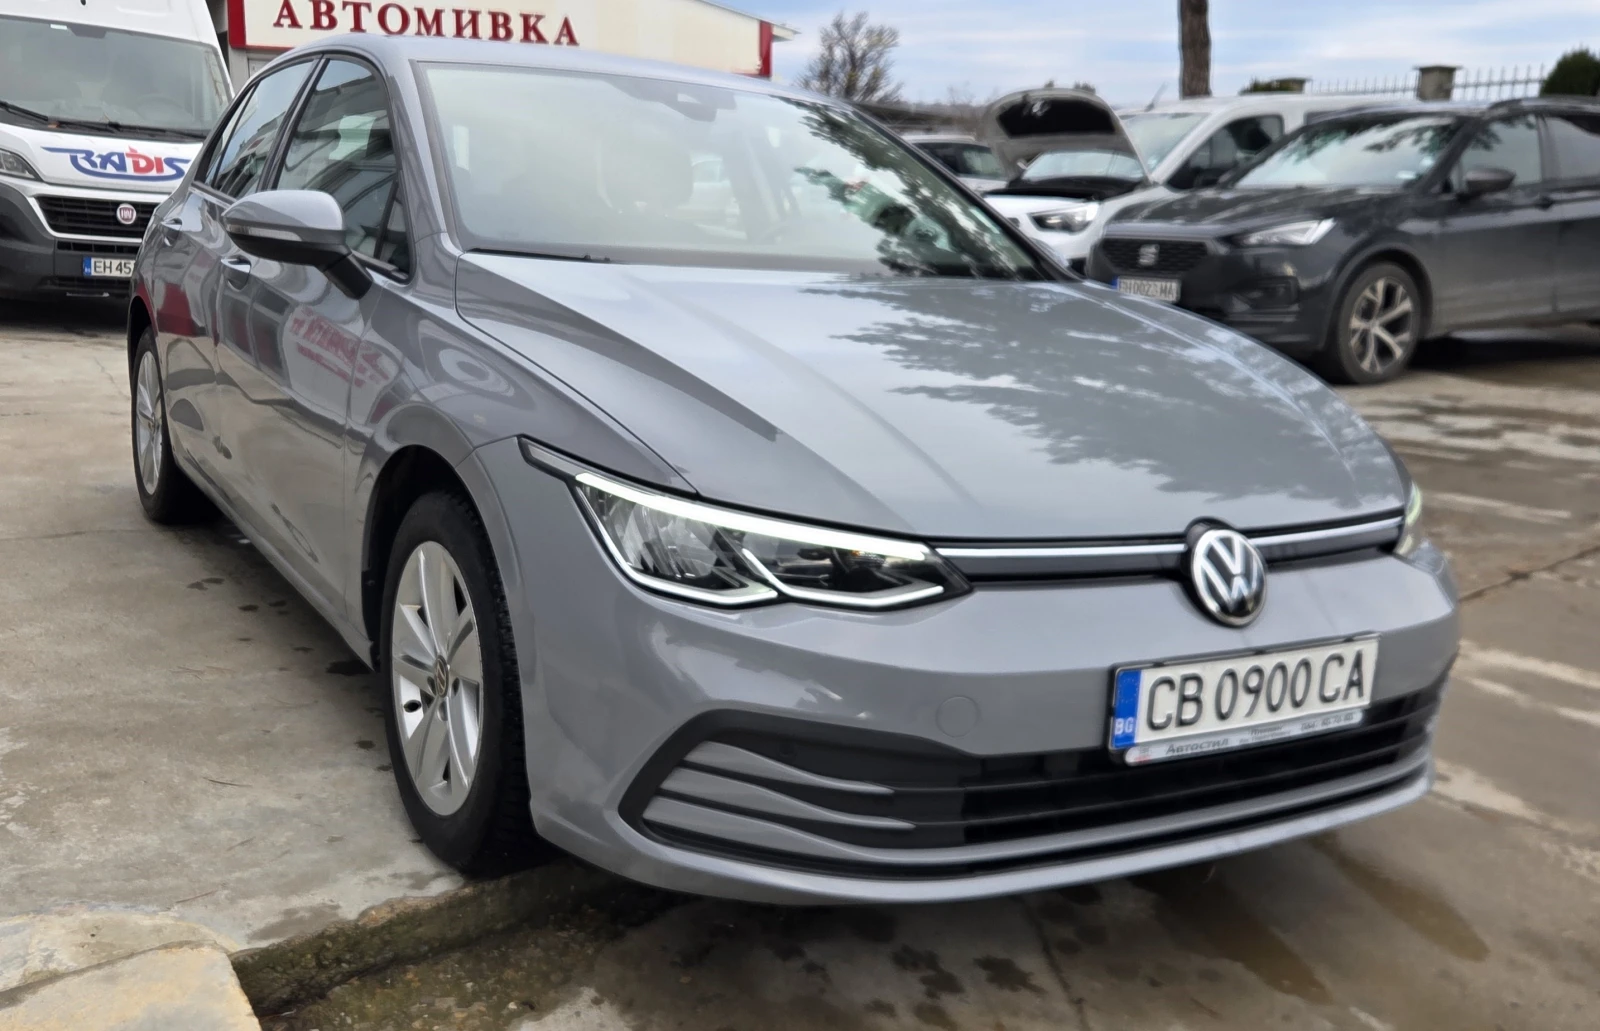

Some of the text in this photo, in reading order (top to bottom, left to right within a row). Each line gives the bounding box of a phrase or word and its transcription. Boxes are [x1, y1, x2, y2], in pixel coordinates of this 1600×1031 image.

[273, 0, 580, 46] АВТОМИВКА
[93, 260, 113, 274] EH
[1147, 649, 1363, 731] CB 0900 CA
[1114, 717, 1134, 735] BG
